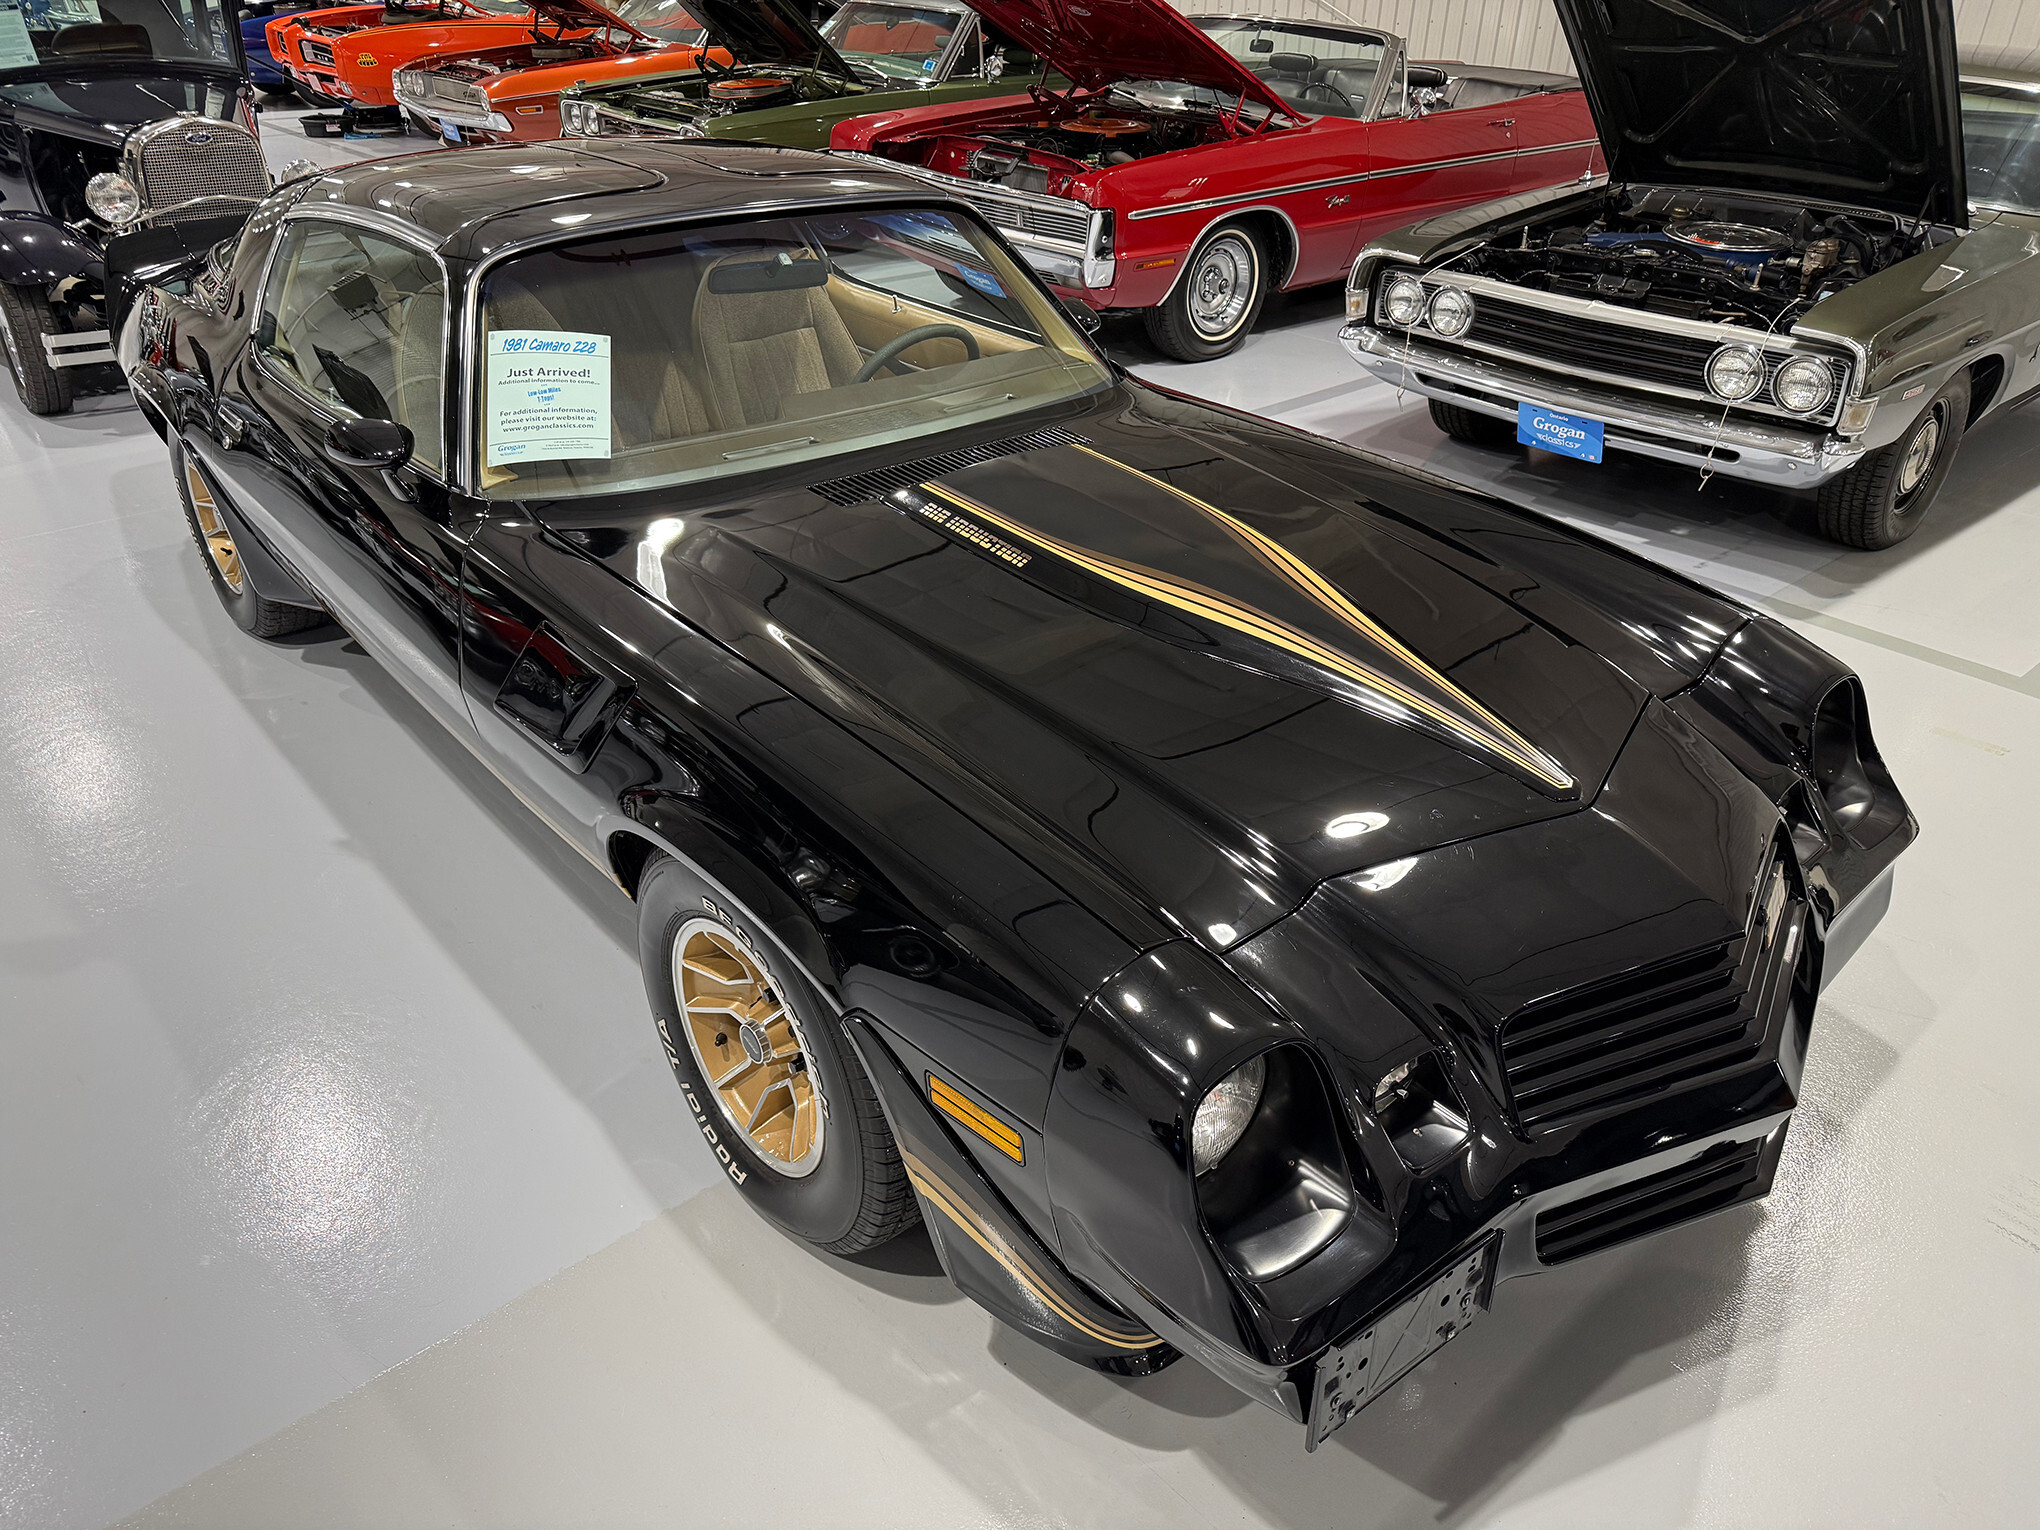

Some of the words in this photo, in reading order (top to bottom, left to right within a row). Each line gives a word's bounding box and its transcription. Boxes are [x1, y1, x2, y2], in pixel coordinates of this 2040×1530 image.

[502, 338, 528, 352] 1981
[528, 338, 571, 353] Camaro
[573, 340, 597, 354] Z28
[507, 368, 533, 378] Just
[537, 367, 591, 378] Arrived!
[498, 378, 530, 386] Additional
[512, 407, 550, 415] additional
[500, 418, 524, 426] please
[502, 423, 594, 433] www.groganclassics.com
[1533, 416, 1586, 440] Grogan
[497, 444, 526, 452] Grogan
[919, 502, 952, 524] AIR
[945, 516, 1033, 568] INDUCTION
[657, 1018, 680, 1070] T/A
